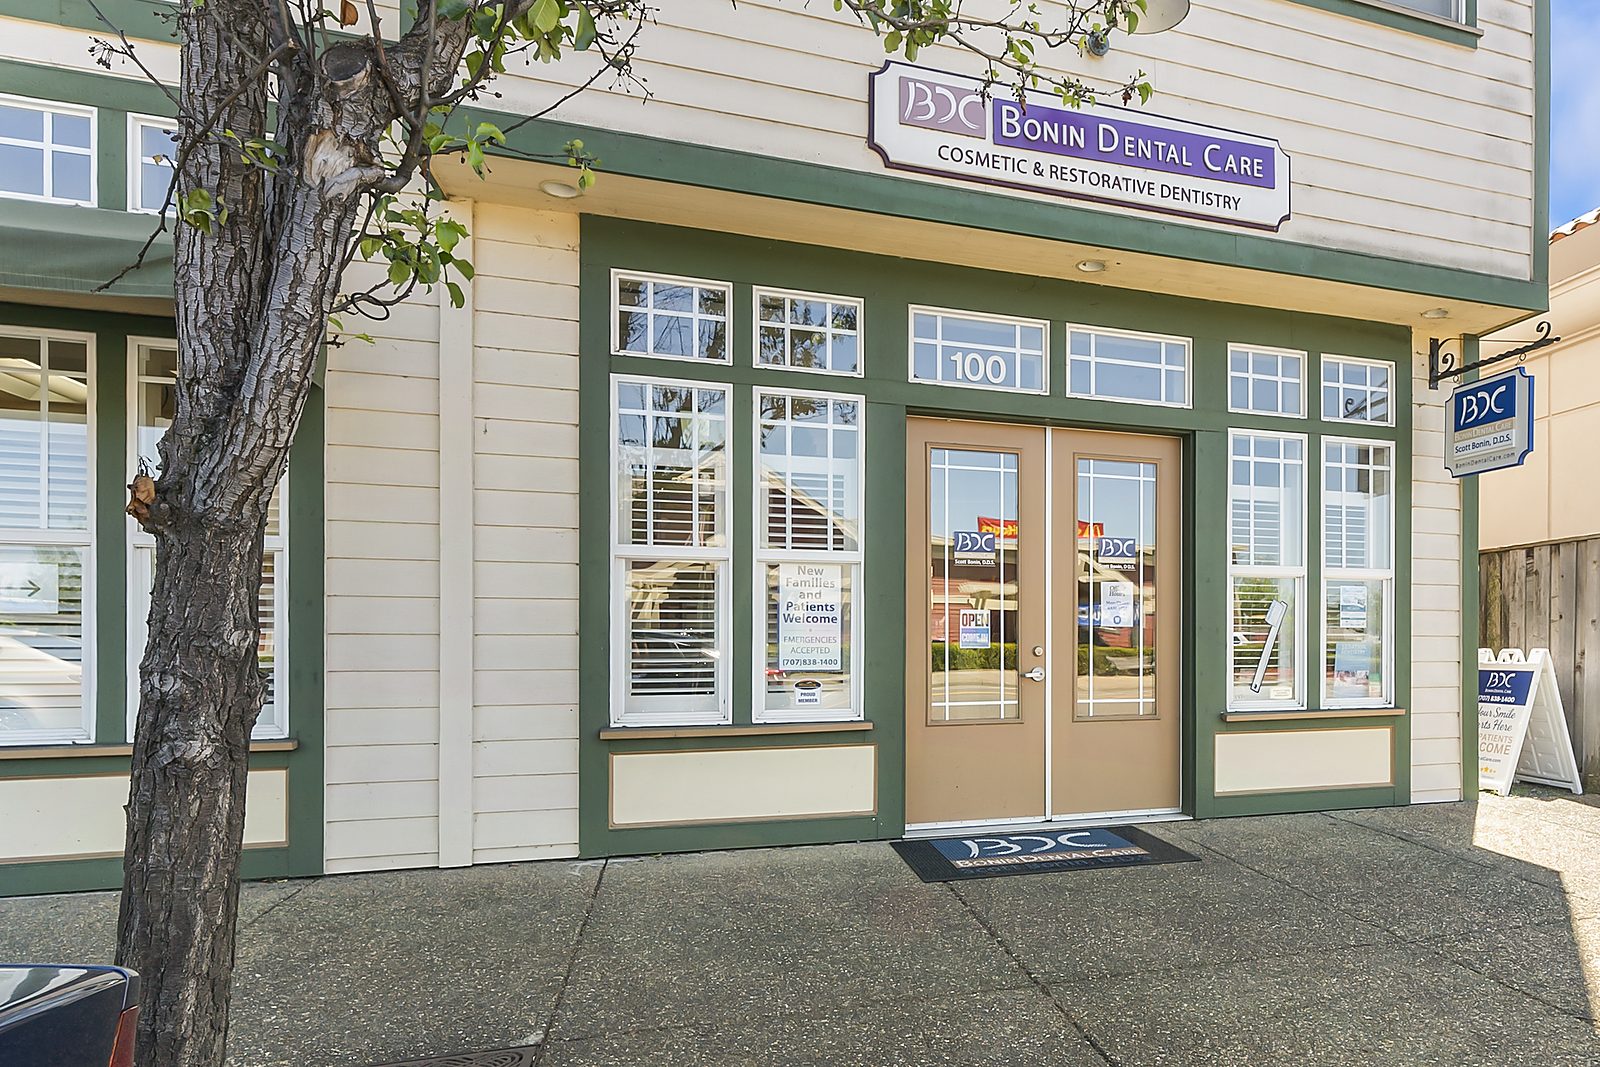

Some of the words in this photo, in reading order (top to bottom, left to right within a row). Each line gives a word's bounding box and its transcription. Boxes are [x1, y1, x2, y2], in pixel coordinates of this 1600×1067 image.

[904, 80, 981, 130] BDC
[938, 145, 1028, 175] COSMETIC
[1033, 163, 1045, 178] &
[1050, 165, 1156, 196] RESTORATIVE
[1160, 184, 1241, 212] DENTISTRY
[950, 351, 1007, 384] 100
[1460, 385, 1507, 426] BDC
[1455, 442, 1471, 454] Scott
[1492, 433, 1512, 445] D.D.S.
[956, 532, 994, 552] BDC
[1100, 538, 1134, 557] BDC
[797, 565, 824, 576] New
[786, 577, 835, 588] Families
[799, 590, 822, 599] and
[786, 601, 835, 612] Patients
[783, 613, 838, 624] Welcome
[961, 613, 990, 627] OPEN
[783, 636, 837, 644] EMERGENCIES
[790, 646, 830, 655] ACCEPTED
[1486, 672, 1516, 688] BDC
[1493, 706, 1516, 719] Smile
[1492, 719, 1513, 732] Here
